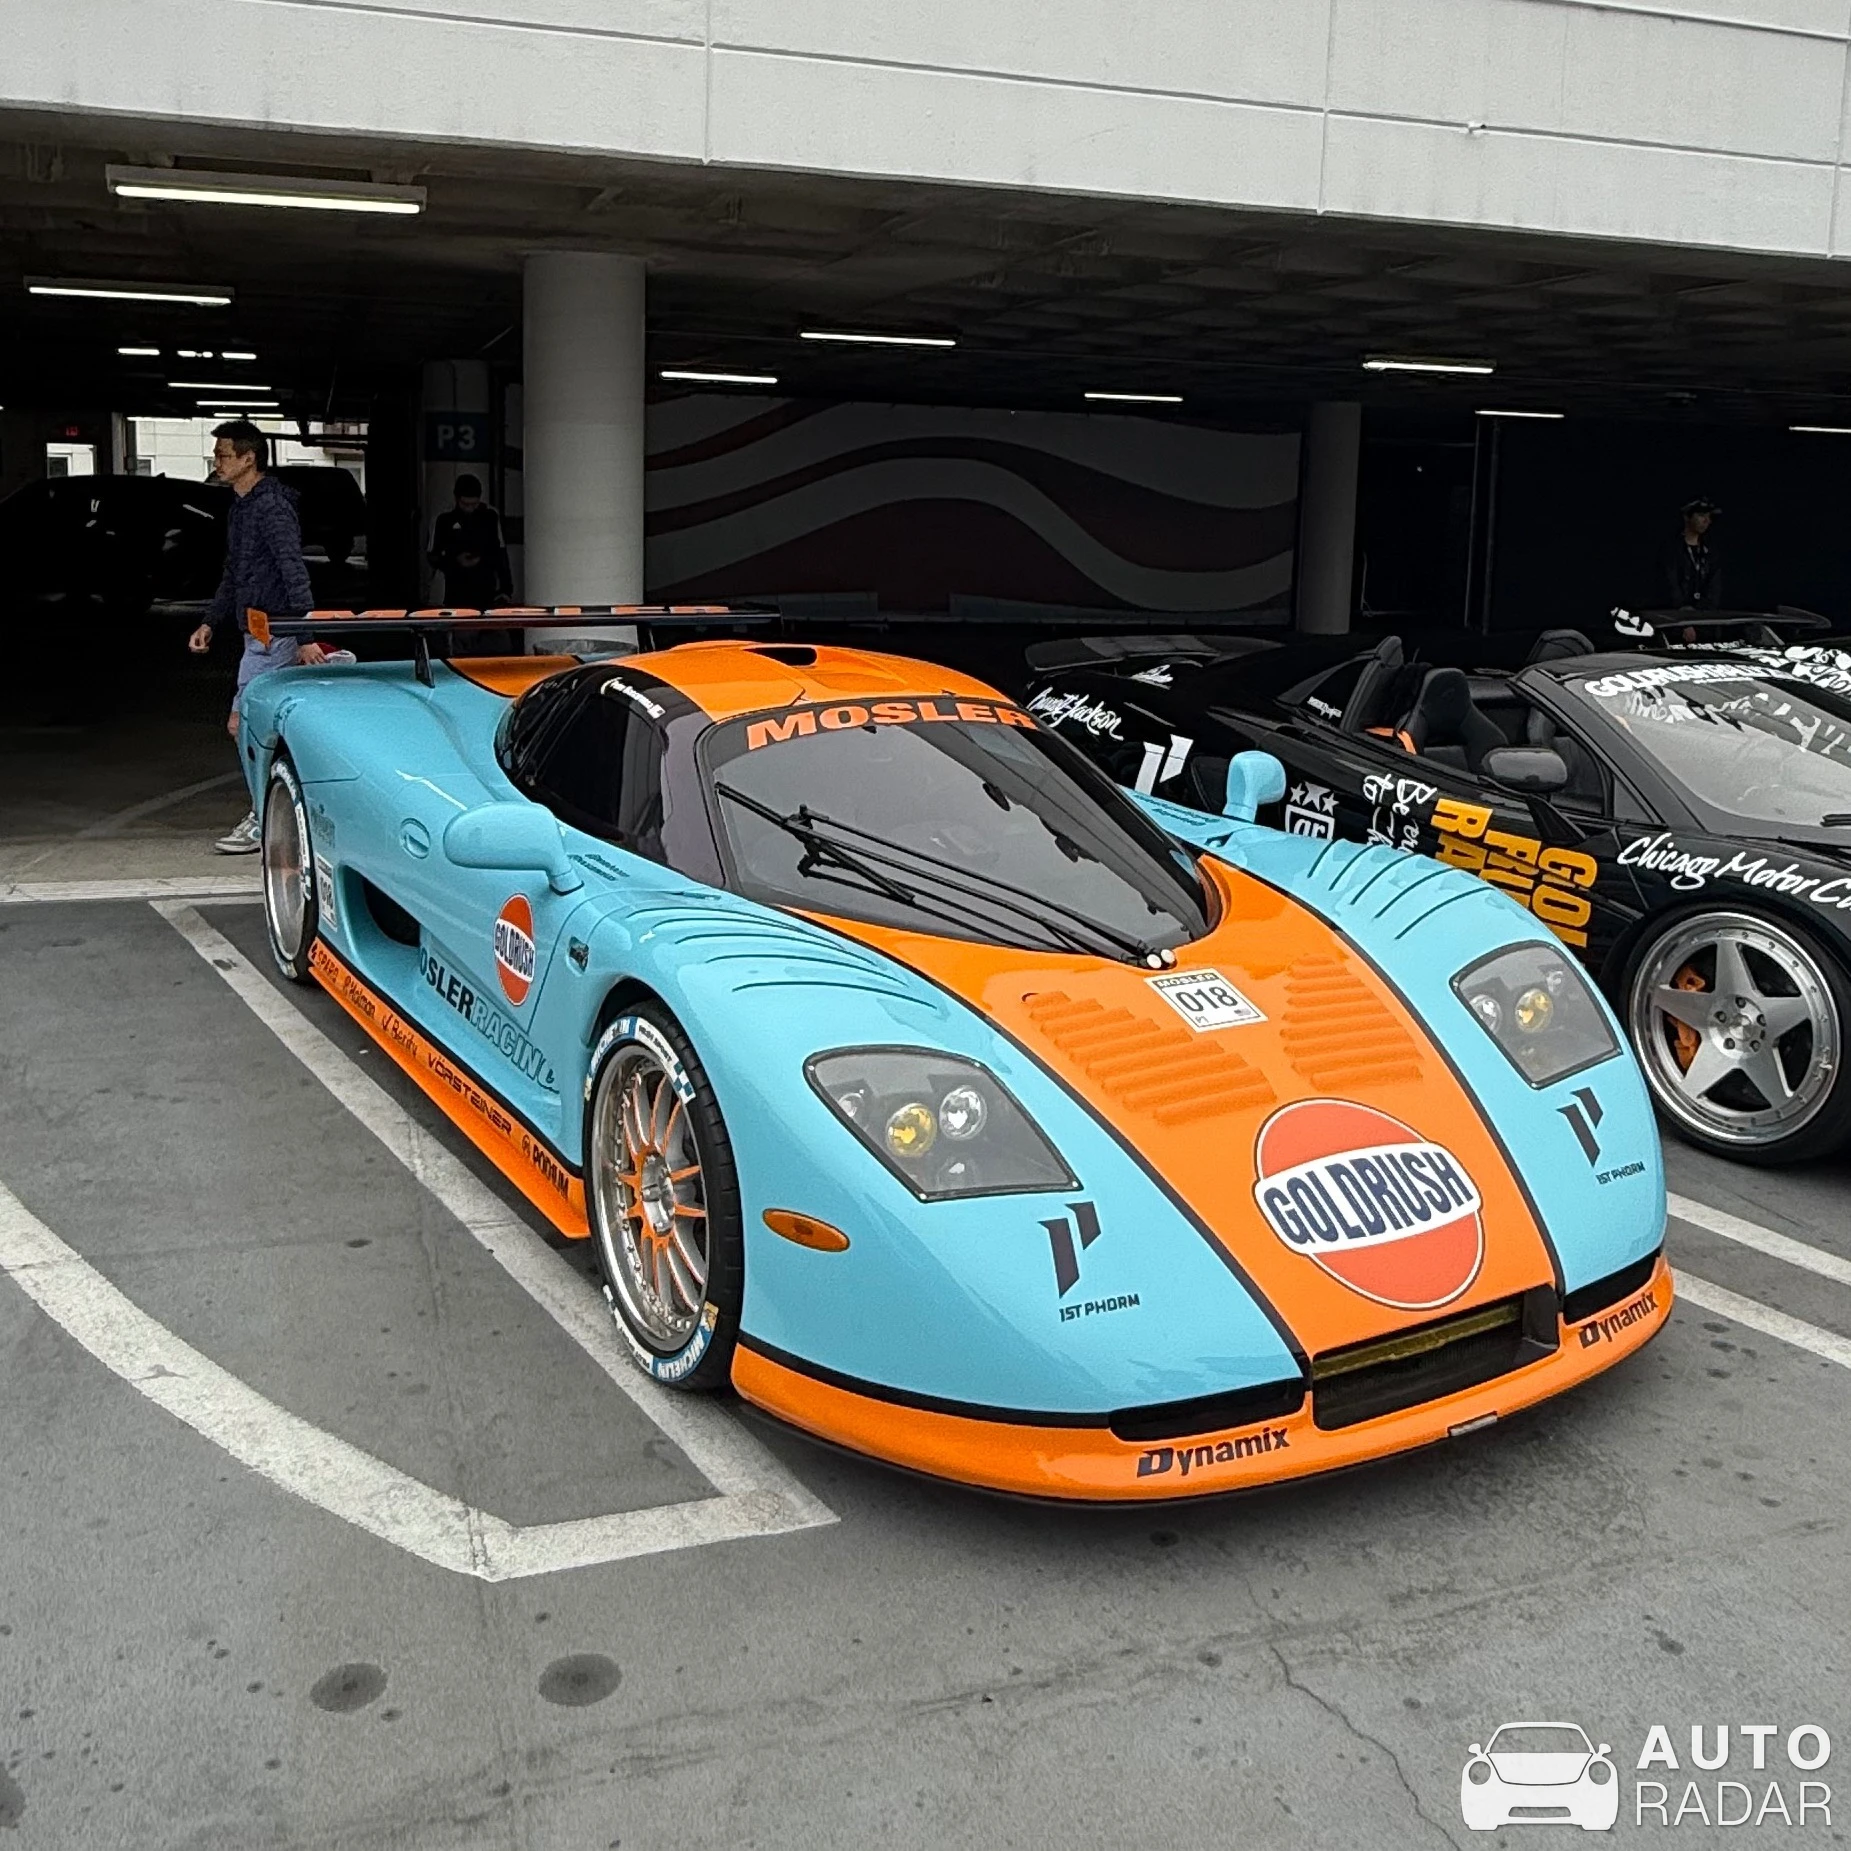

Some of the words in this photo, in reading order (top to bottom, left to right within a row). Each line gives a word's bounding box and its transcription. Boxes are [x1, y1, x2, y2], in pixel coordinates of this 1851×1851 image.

[438, 425, 475, 449] P3
[746, 703, 1038, 750] MOSLER
[1617, 832, 1720, 890] Chicago
[1713, 851, 1820, 895] Motor
[1175, 986, 1238, 1012] 018
[1263, 1151, 1474, 1244] GOLDRUSH
[1059, 1304, 1082, 1322] 1ST
[1085, 1293, 1140, 1316] PHORM
[1579, 1291, 1659, 1349] Dynamix
[1136, 1427, 1290, 1478] Dynamix
